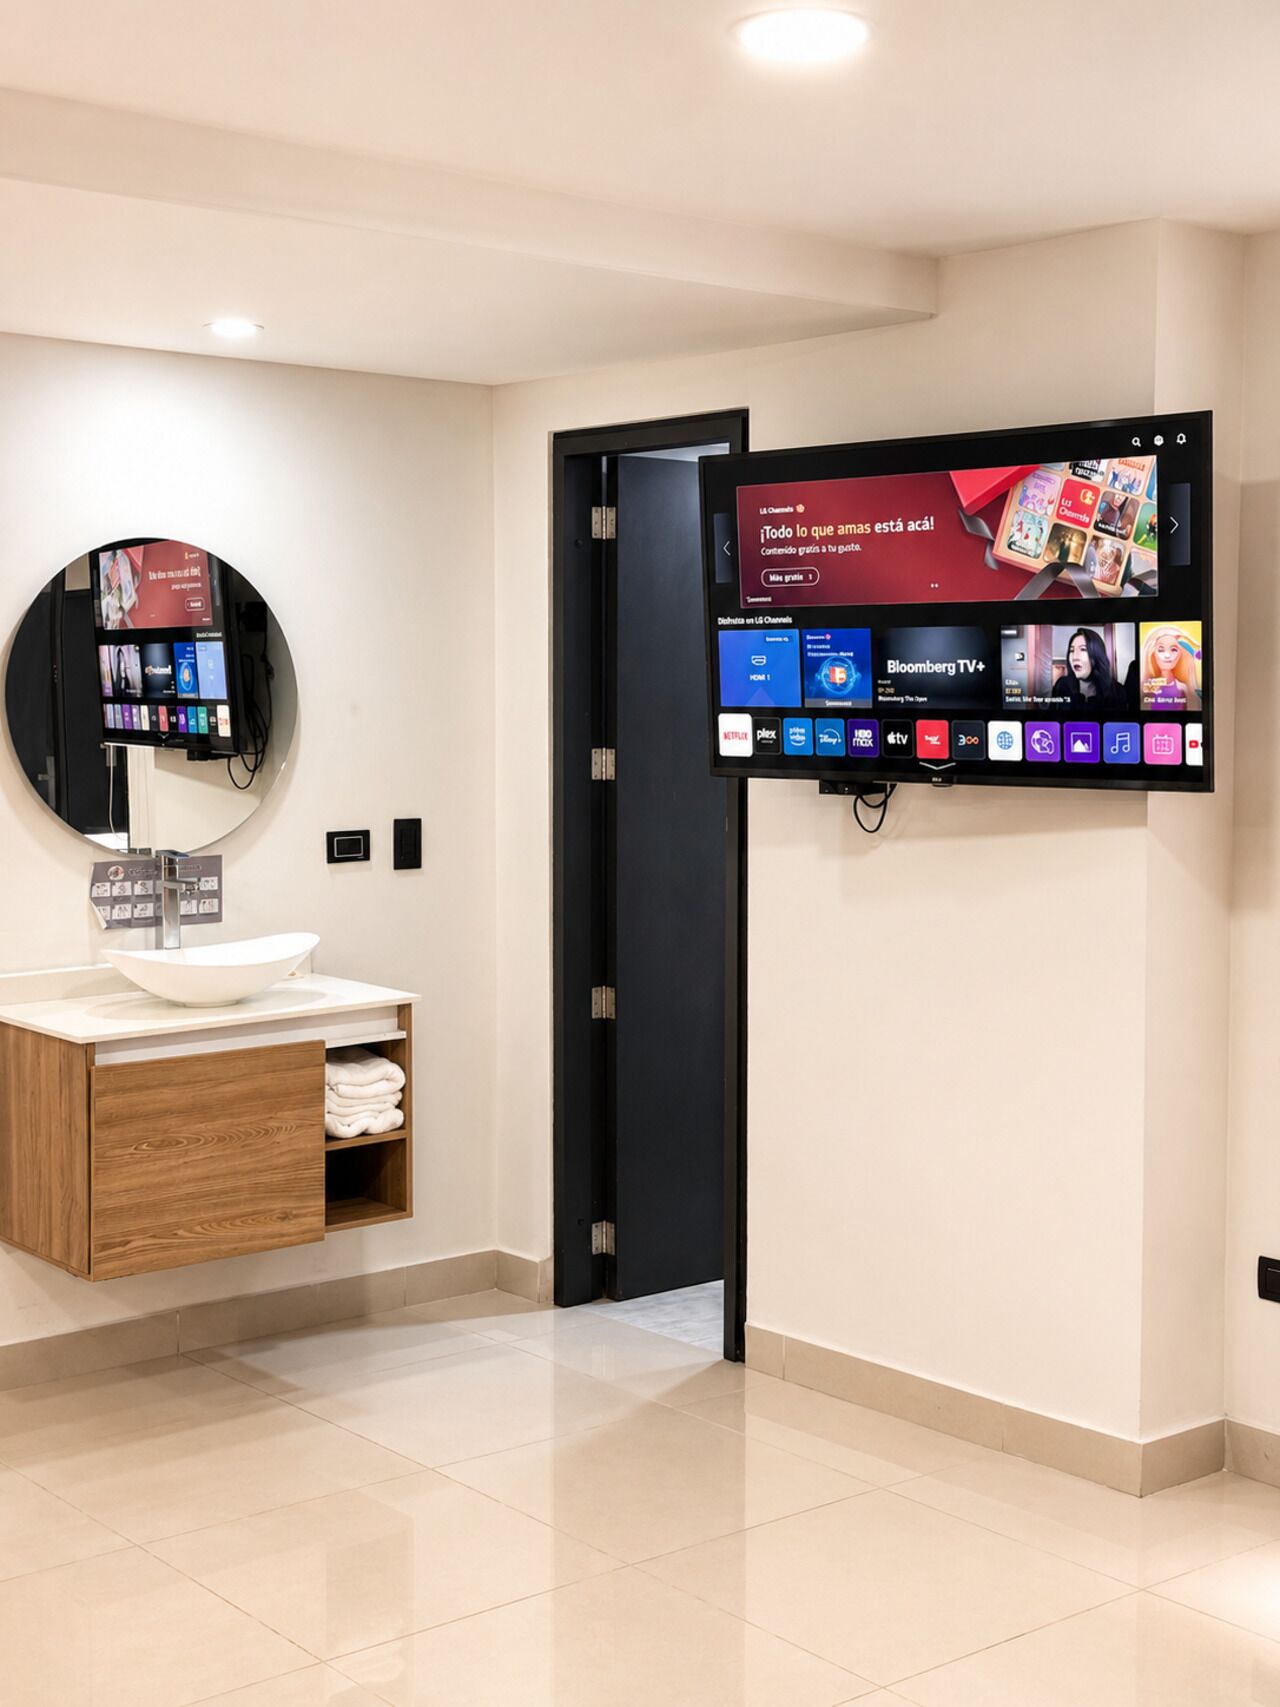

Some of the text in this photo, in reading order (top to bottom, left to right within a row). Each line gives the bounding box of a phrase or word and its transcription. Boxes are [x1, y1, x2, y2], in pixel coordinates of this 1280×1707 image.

[760, 516, 935, 544] ¡Todo lo que amas está acá!
[761, 546, 797, 556] Contenido
[828, 545, 837, 553] tu
[755, 616, 764, 624] LG
[764, 615, 793, 624] Channels
[887, 659, 986, 676] Bloomberg TV+
[723, 731, 749, 741] NETFLIX
[757, 728, 777, 741] plex
[855, 729, 872, 739] HBO
[853, 738, 873, 747] max
